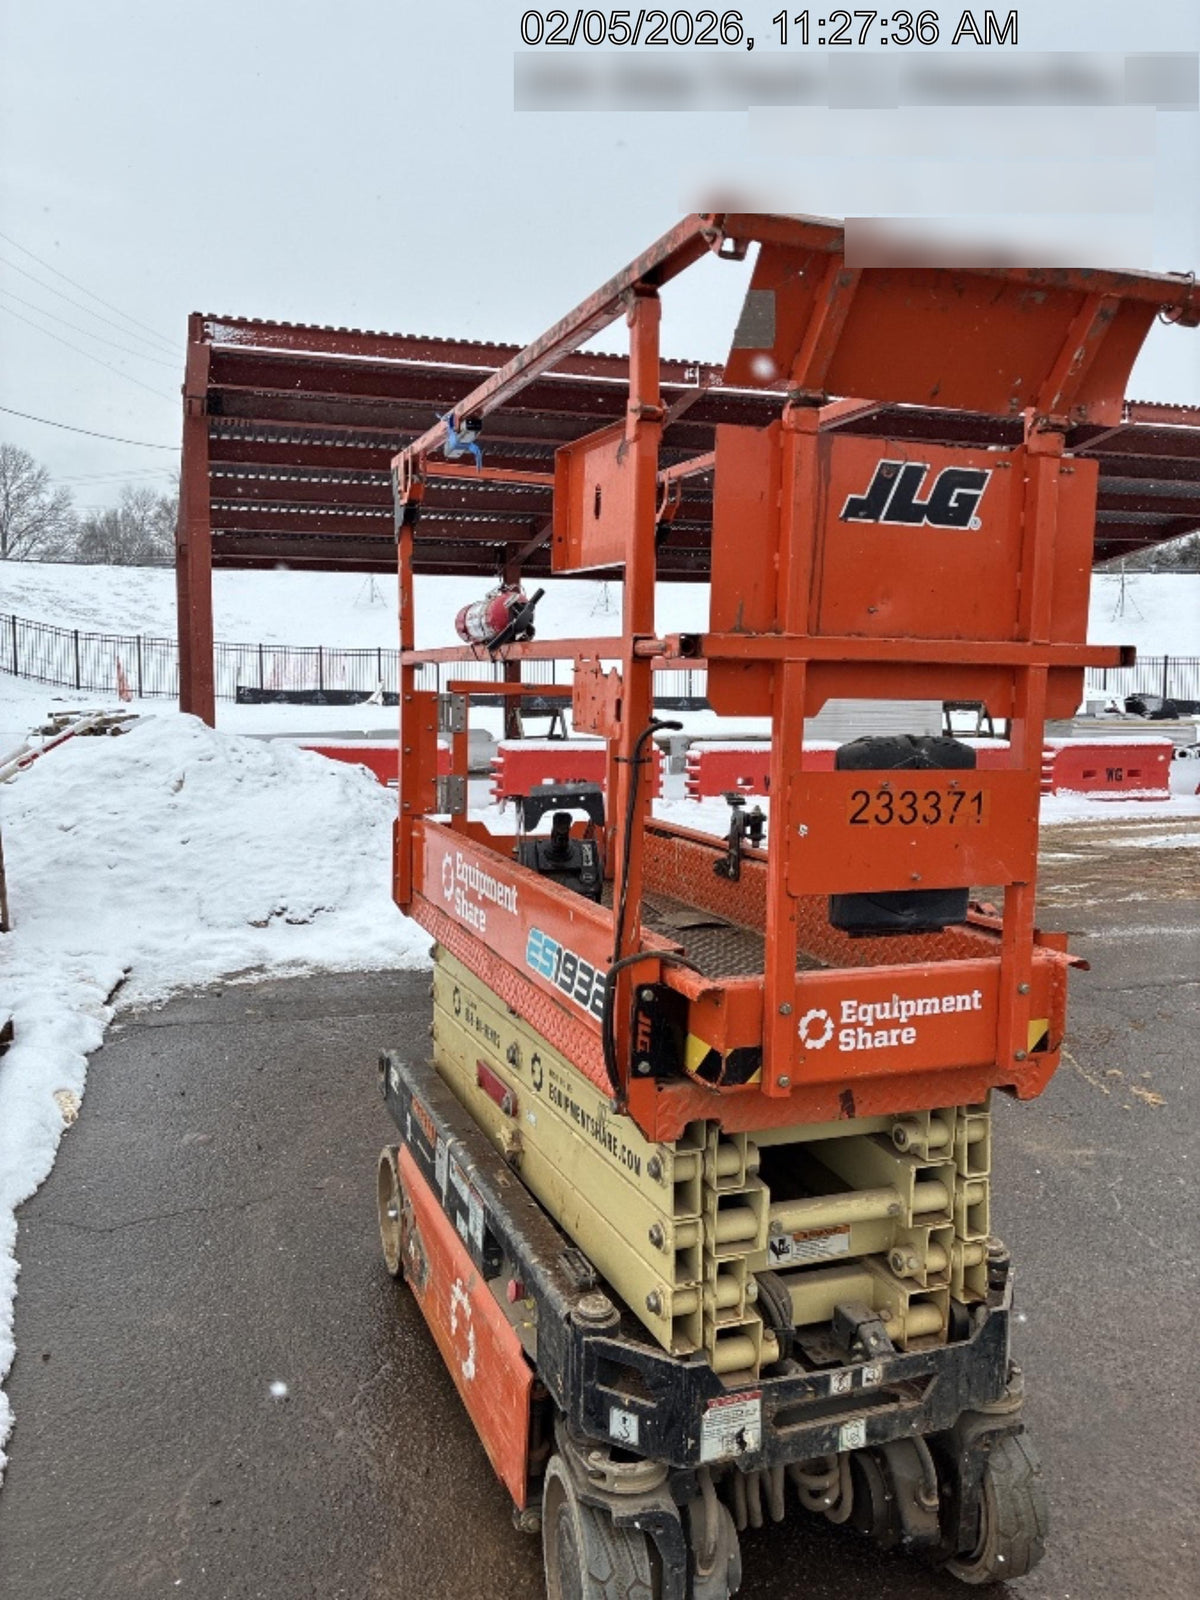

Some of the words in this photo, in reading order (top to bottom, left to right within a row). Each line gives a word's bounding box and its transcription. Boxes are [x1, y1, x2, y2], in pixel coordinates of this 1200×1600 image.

[839, 458, 993, 531] JLG
[849, 790, 983, 825] 233371
[456, 851, 519, 916] Equipment
[454, 886, 487, 933] Share
[840, 989, 983, 1027] Equipment
[838, 1026, 917, 1052] Share
